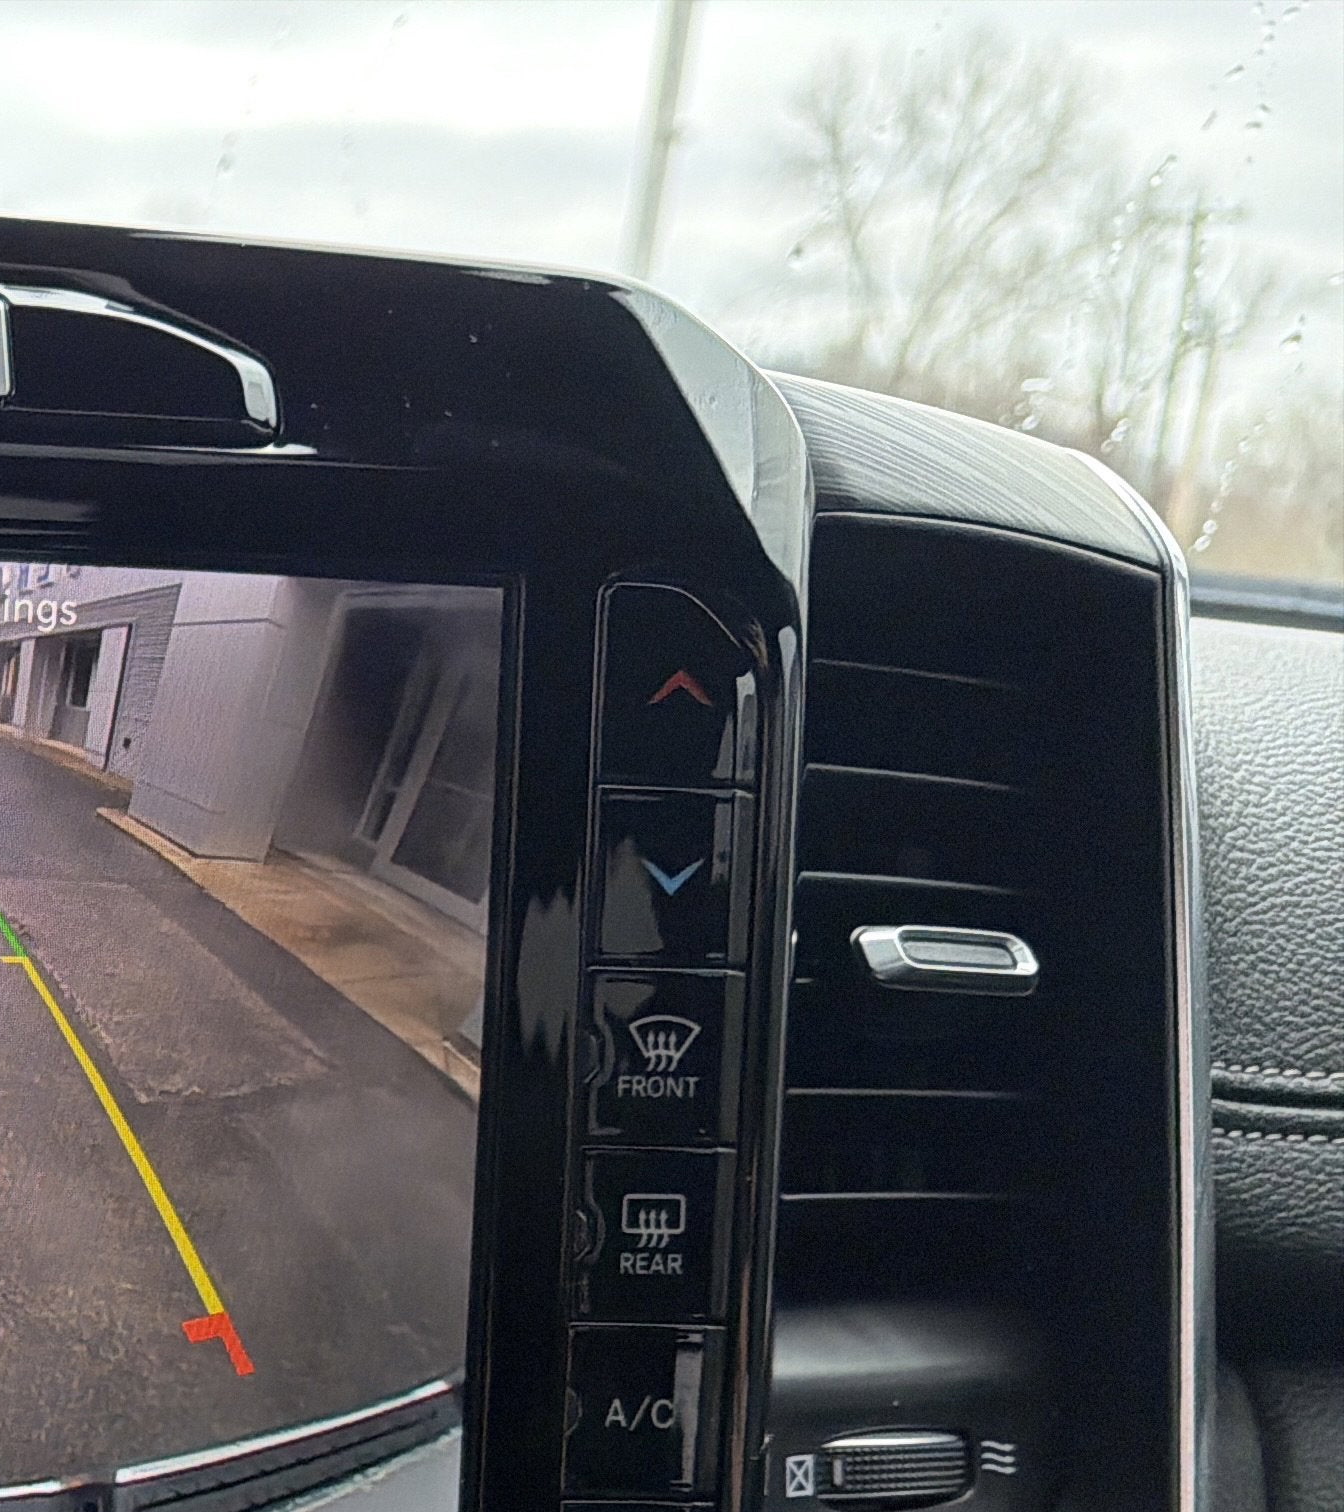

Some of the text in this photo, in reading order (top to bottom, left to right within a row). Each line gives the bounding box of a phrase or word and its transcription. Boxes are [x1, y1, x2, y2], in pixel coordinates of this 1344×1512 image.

[617, 1074, 700, 1099] FRONT
[619, 1252, 683, 1275] REAR
[604, 1396, 676, 1431] A/C
